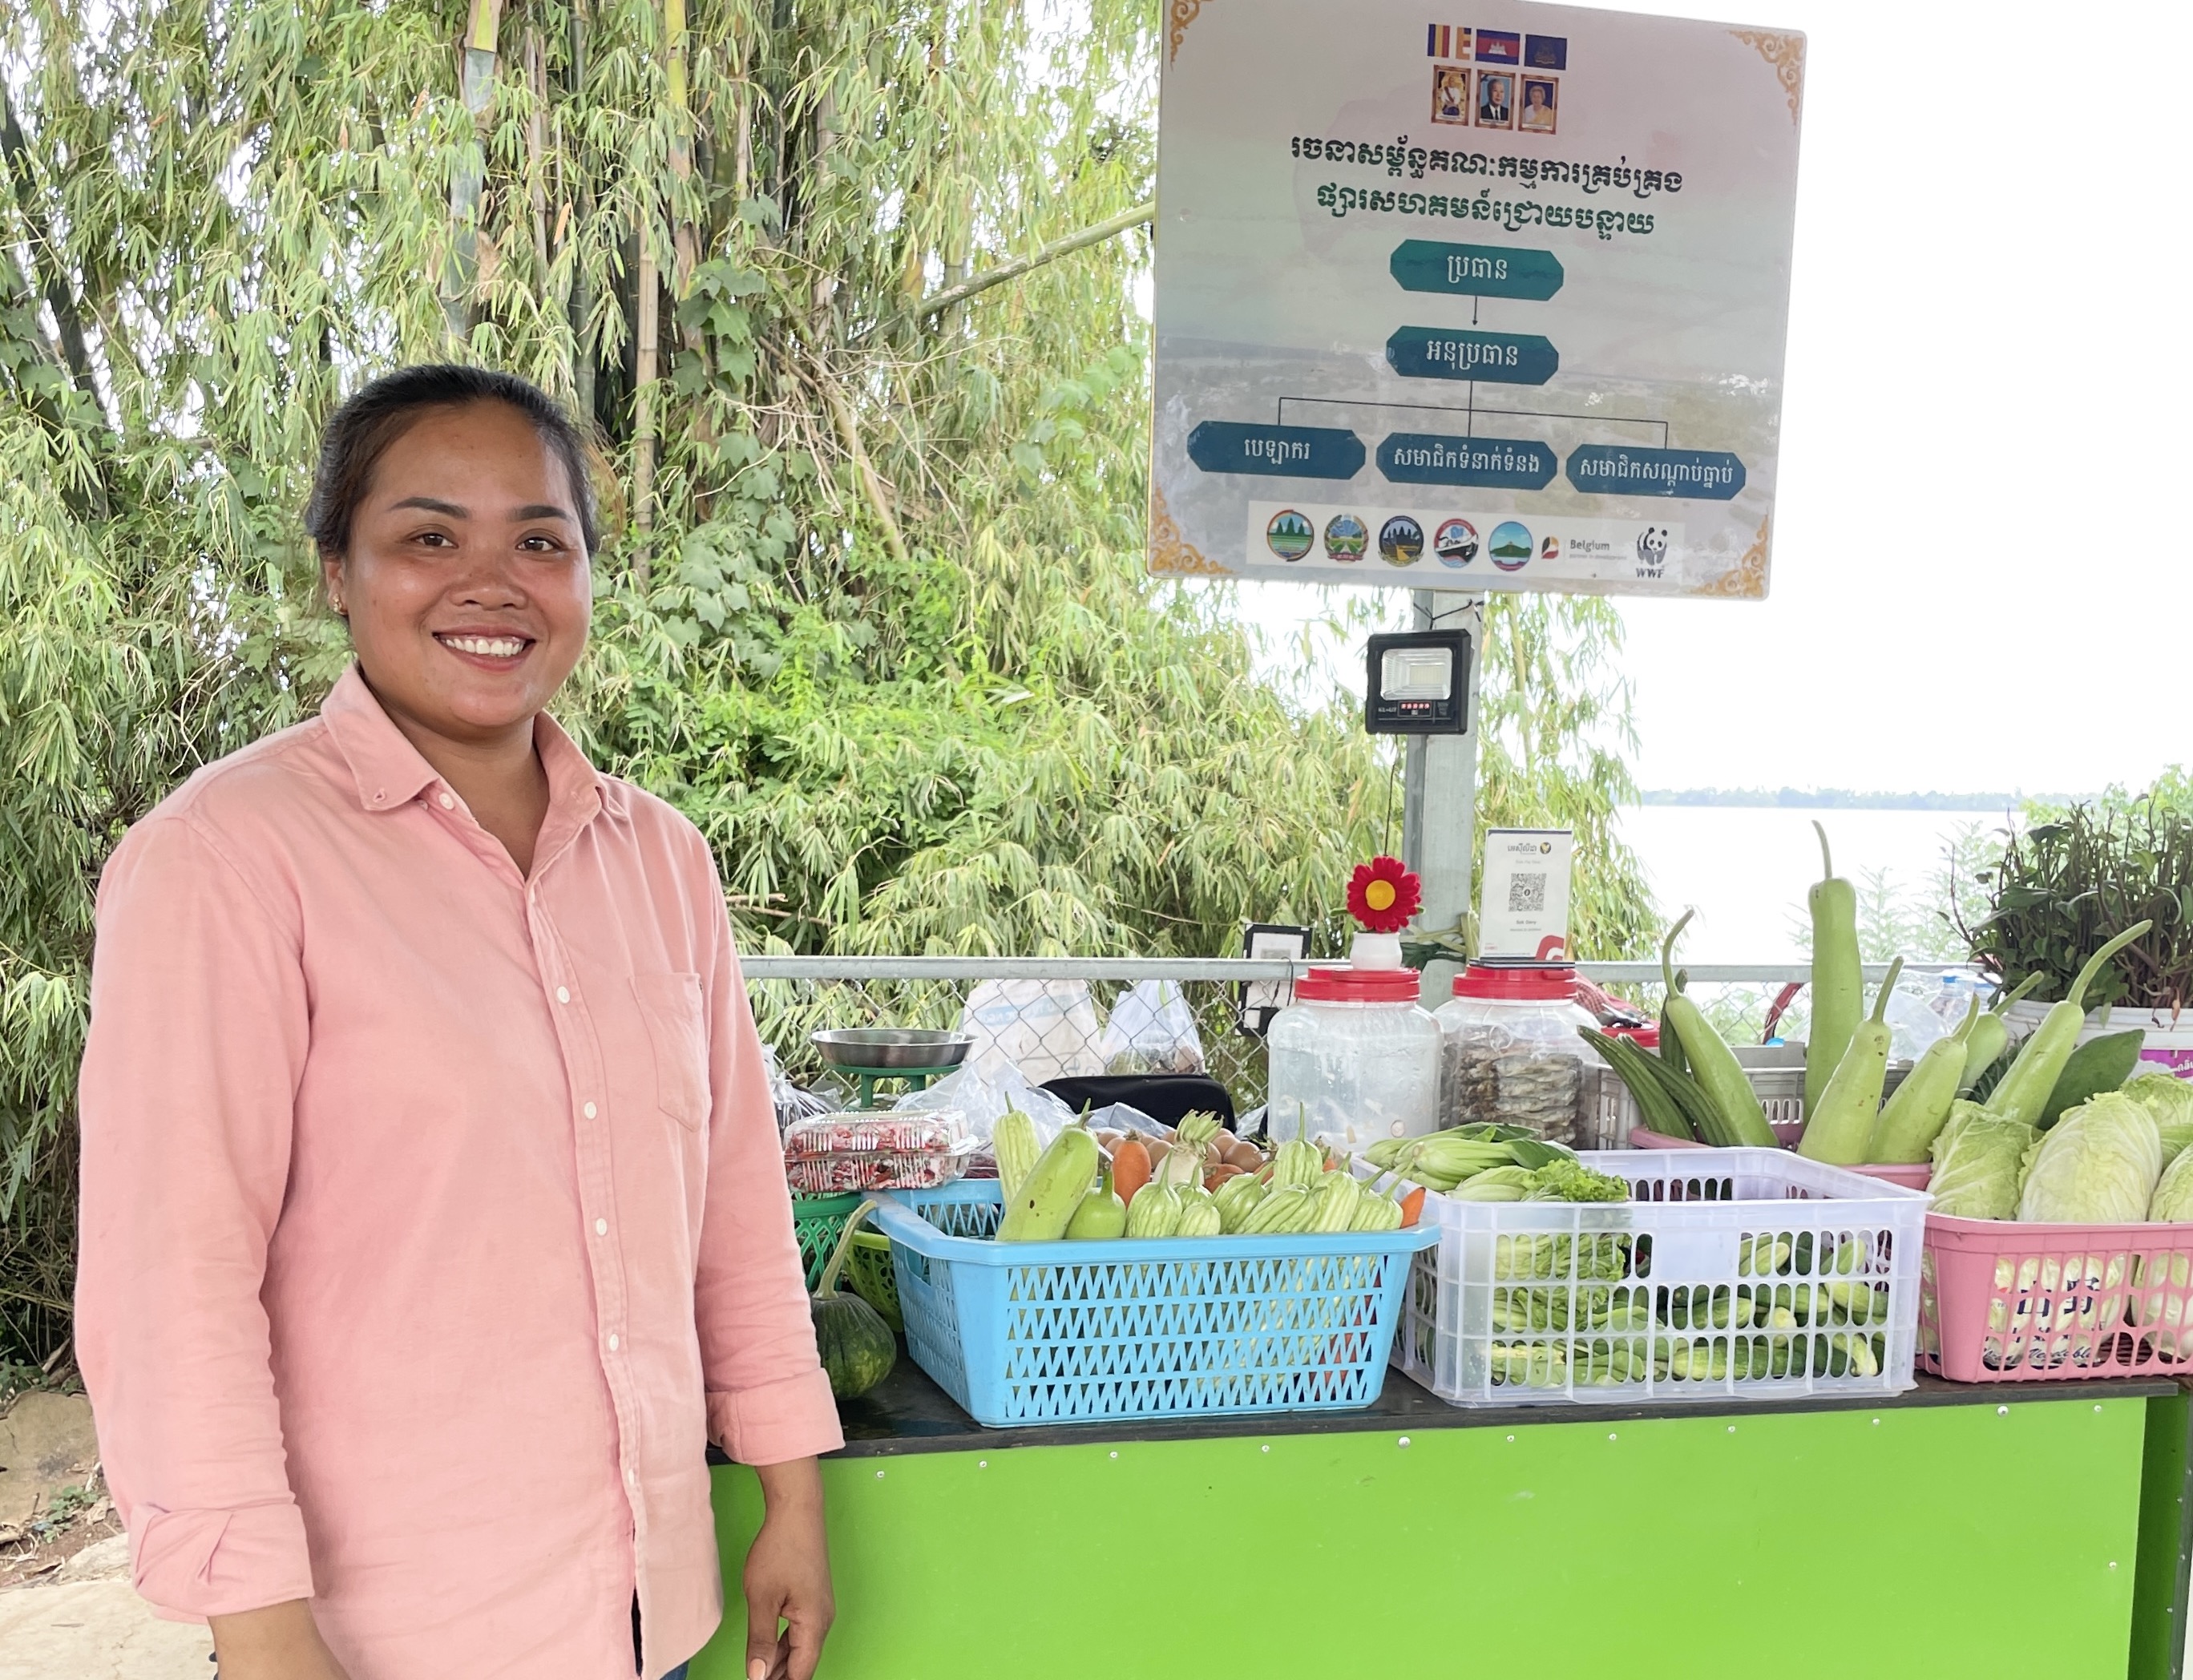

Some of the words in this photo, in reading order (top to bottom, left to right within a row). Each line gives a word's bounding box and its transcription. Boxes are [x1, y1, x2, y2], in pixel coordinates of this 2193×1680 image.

[1447, 255, 1508, 284] ប្រធាន
[1426, 340, 1518, 371] អនុប្រធាន
[1244, 438, 1311, 465] បេឡាករ
[1394, 442, 1540, 473] សមាជិកទំនាក់ទំនង
[1569, 539, 1610, 552] Belgium
[1635, 567, 1665, 579] WWF
